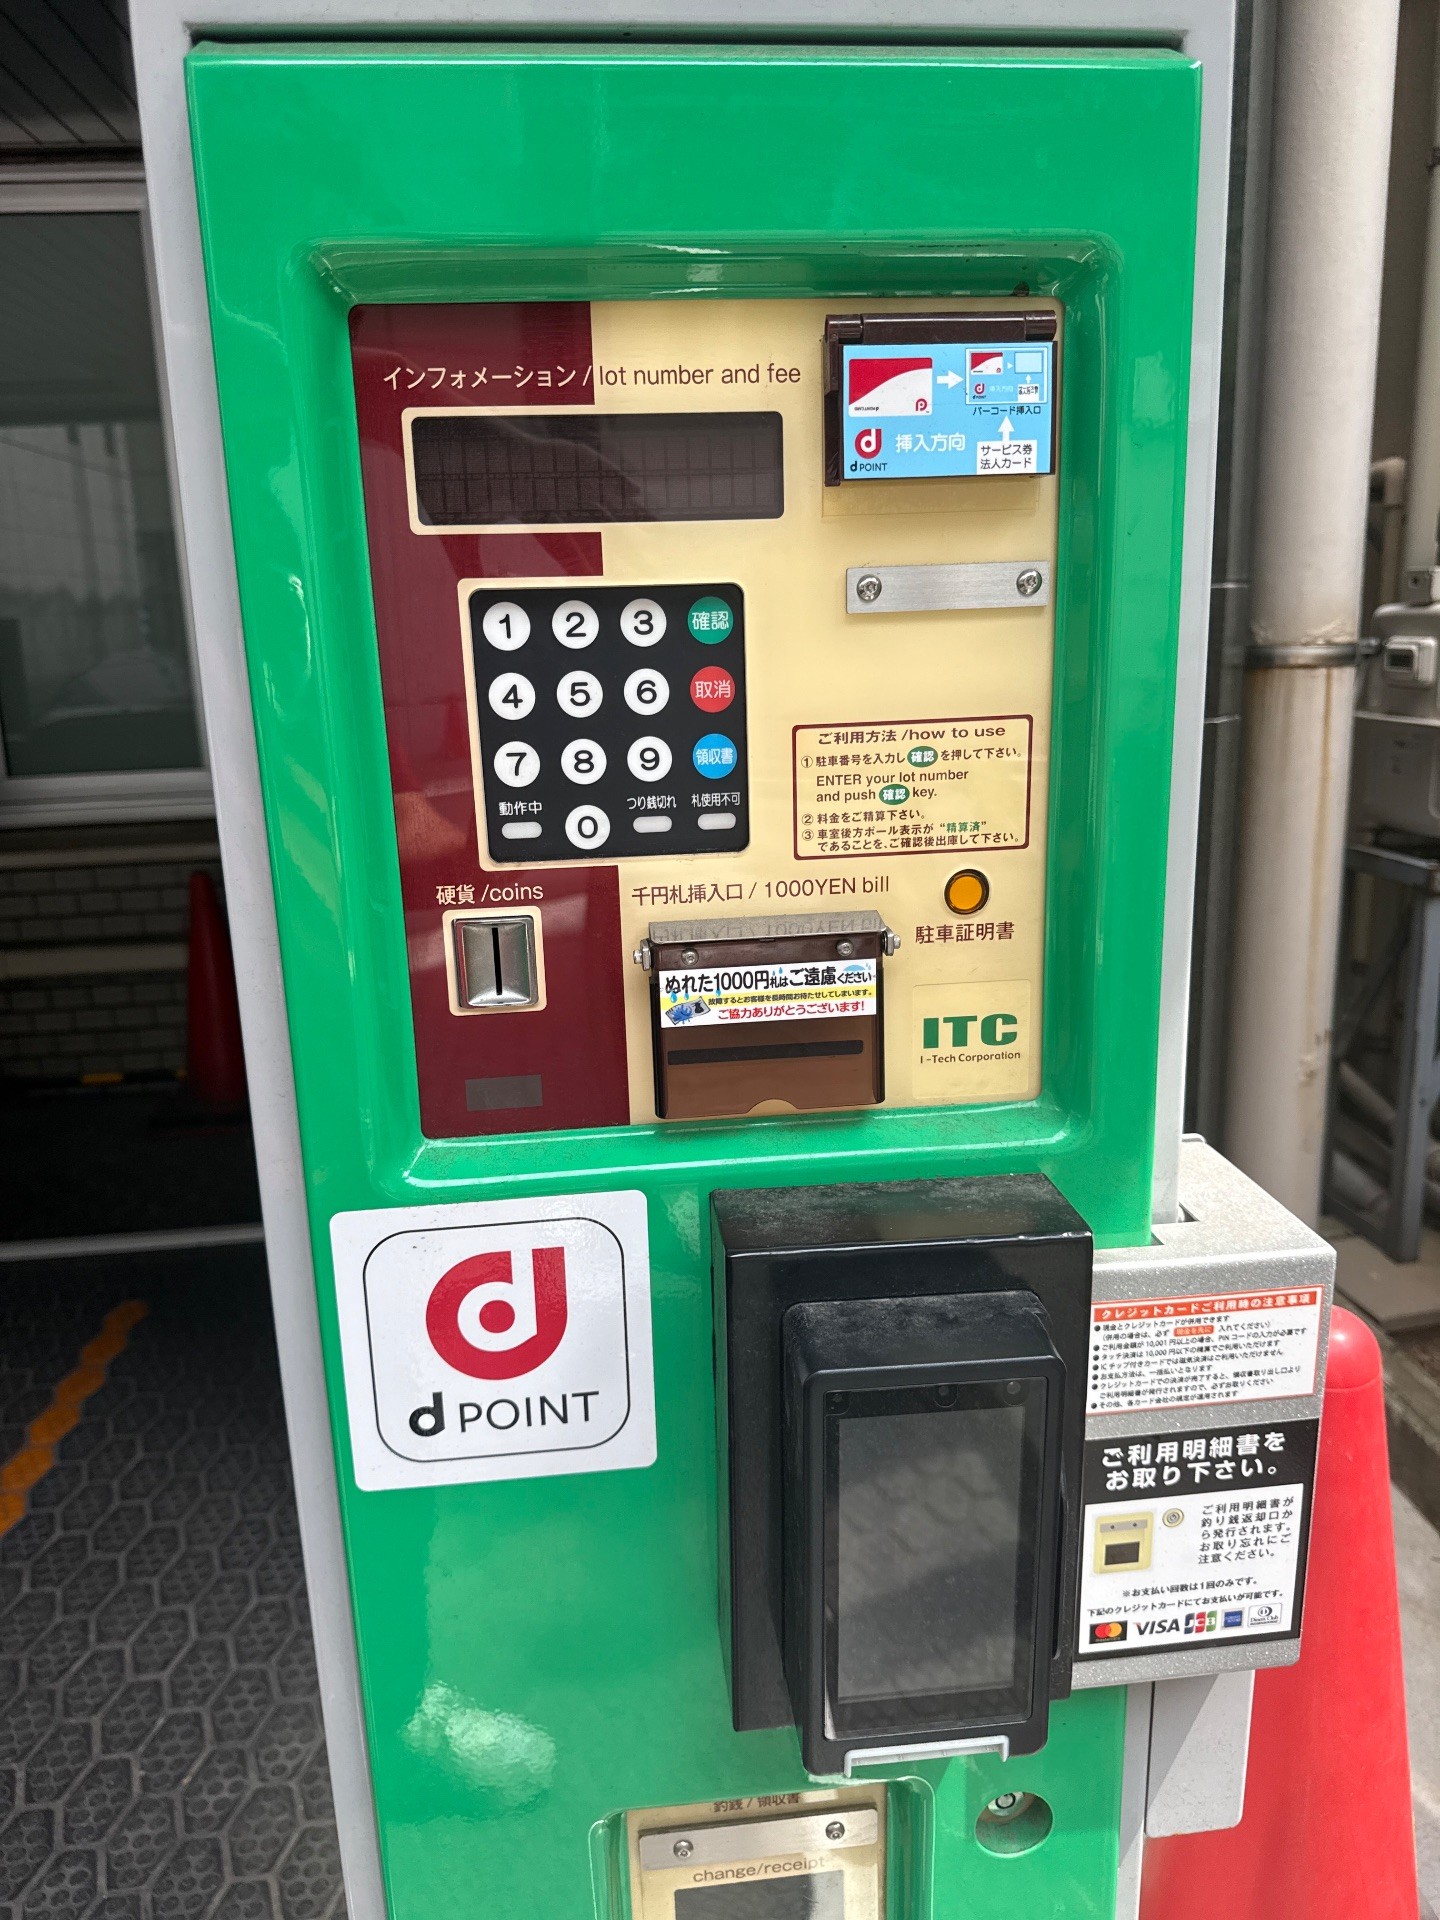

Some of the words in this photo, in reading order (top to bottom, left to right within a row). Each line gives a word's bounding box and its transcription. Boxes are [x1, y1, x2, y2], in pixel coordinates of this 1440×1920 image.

[383, 365, 576, 391] インフォメーション
[600, 365, 627, 386] lot
[634, 364, 714, 386] number
[721, 363, 760, 385] and
[767, 363, 801, 384] fee
[972, 405, 1041, 416] バーコード挿入口
[895, 433, 966, 454] 挿入方向
[981, 443, 1033, 457] サービス券
[860, 463, 887, 472] POINT
[980, 457, 1032, 470] 法人カード
[499, 614, 512, 639] 1
[566, 612, 586, 637] 2
[634, 610, 654, 635] 3
[691, 612, 729, 631] 確認
[502, 684, 523, 709] 4
[569, 682, 591, 707] 5
[636, 680, 657, 704] 6
[695, 681, 731, 699] 取消
[818, 729, 897, 745] ご利用方法
[952, 727, 969, 739] to
[974, 726, 1006, 738] use
[506, 752, 527, 777] 7
[574, 750, 595, 774] 8
[639, 747, 660, 771] 9
[696, 748, 733, 765] 領収書
[817, 774, 862, 787] ENTER
[866, 773, 895, 788] your
[900, 771, 915, 783] lot
[919, 769, 969, 783] number
[627, 795, 677, 810] つり銭切れ
[691, 792, 741, 807] 札使用不可
[816, 790, 840, 802] and
[844, 789, 876, 804] push
[882, 788, 906, 801] 確認
[912, 786, 937, 800] key.
[498, 801, 543, 816] 動作中
[577, 816, 598, 839] 0
[436, 884, 476, 906] 硬貨
[631, 883, 743, 906] 千円札挿入口
[765, 878, 856, 898] 1000YEN
[862, 875, 890, 893] bill
[915, 921, 1015, 944] 駐車証明書
[923, 1013, 1018, 1049] ITC
[958, 1051, 1021, 1062] Corporation
[1101, 1293, 1311, 1320] クレジットカードご利用時の注意事項
[459, 1390, 599, 1433] POINT
[1102, 1431, 1286, 1468] ご利用明細書を
[1105, 1458, 1278, 1491] お取り下さい。
[1202, 1496, 1294, 1515] ご利用明細書が
[1133, 1618, 1180, 1636] VISA
[1184, 1610, 1217, 1634] JCB
[693, 1856, 825, 1883] change/receipt
